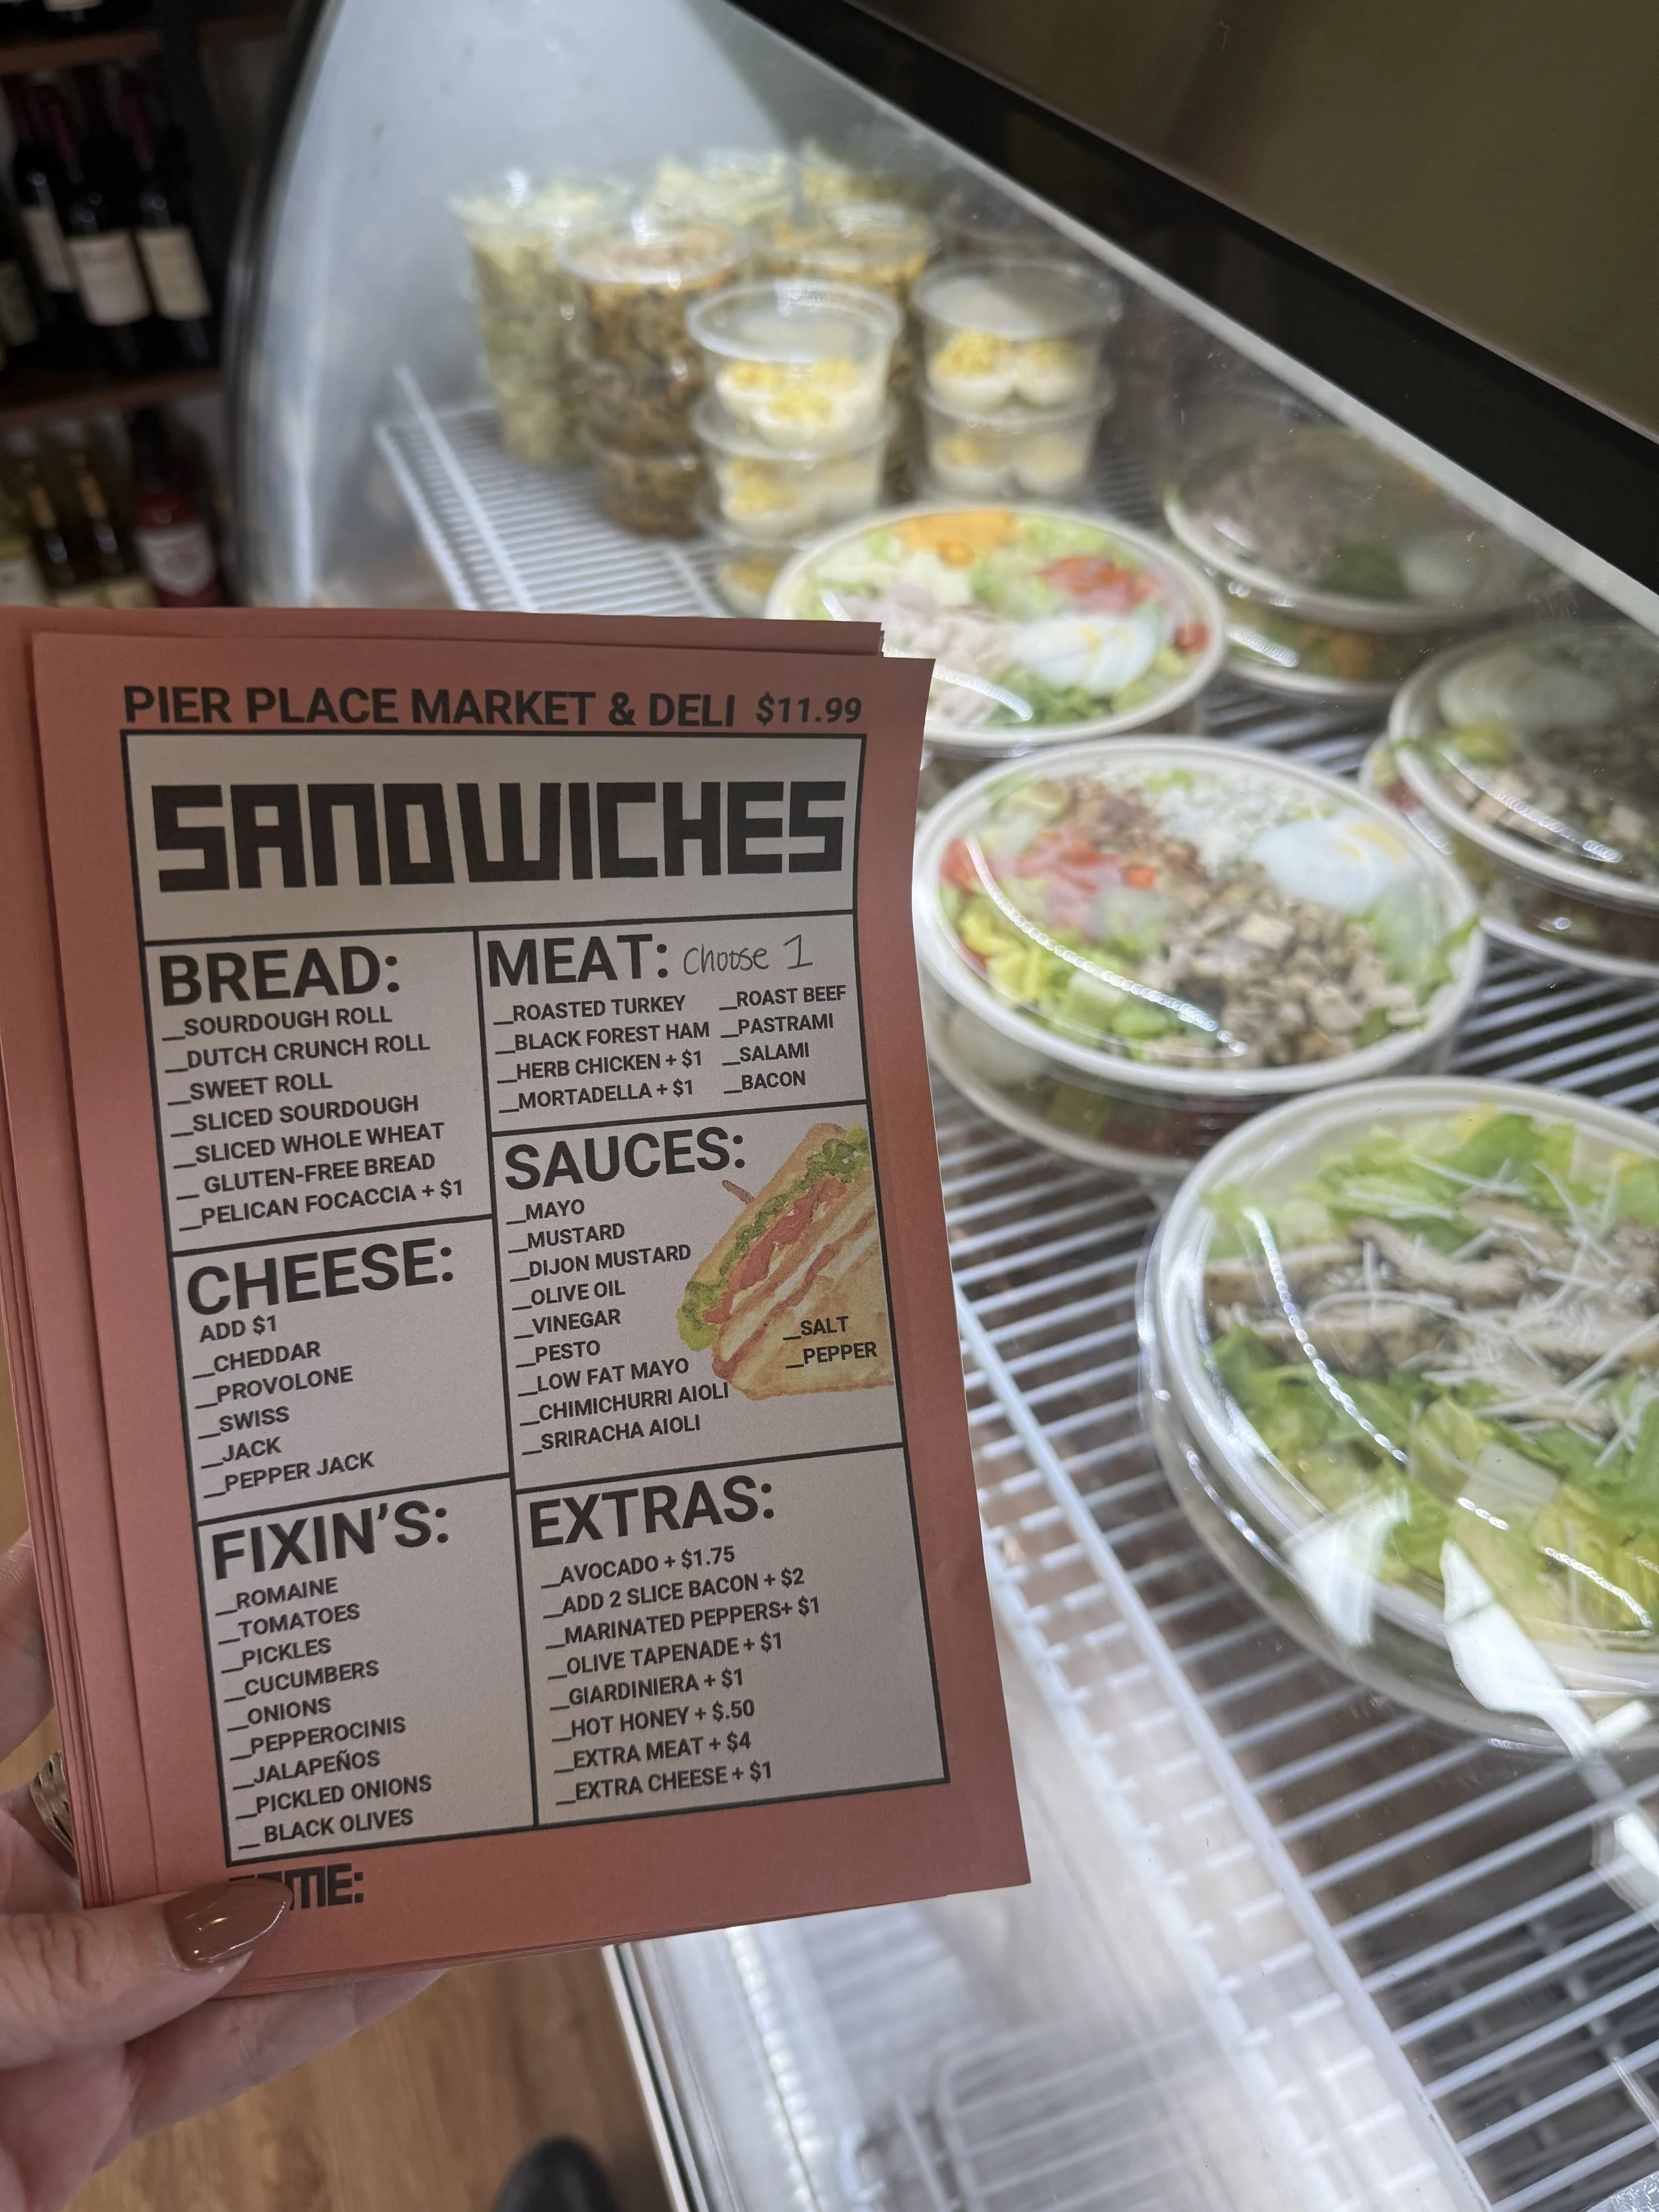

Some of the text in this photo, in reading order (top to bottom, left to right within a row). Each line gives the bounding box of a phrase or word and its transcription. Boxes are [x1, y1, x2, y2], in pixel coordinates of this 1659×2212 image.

[124, 686, 861, 727] PIER PLACE MARKET & DELI $11.99
[152, 781, 845, 892] SANDWICHES
[488, 934, 668, 987] MEAT:
[784, 934, 813, 969] 1
[160, 946, 399, 1005] BREAD:
[611, 995, 685, 1015] TURKEY
[804, 985, 845, 1002] BEEF
[336, 1006, 392, 1025] ROLL
[587, 1025, 660, 1045] FOREST
[666, 1021, 709, 1040] HAM
[274, 1038, 368, 1061] CRUNCH
[375, 1034, 430, 1053] ROLL
[575, 1053, 660, 1074] CHICKEN
[666, 1055, 676, 1066] +
[682, 1049, 701, 1069] $1
[275, 1072, 332, 1092] ROLL
[657, 1084, 668, 1095] +
[674, 1078, 692, 1098] $1
[280, 1095, 418, 1123] SOURDOUGH
[281, 1130, 362, 1153] WHOLE
[366, 1122, 445, 1145] WHEAT
[506, 1127, 745, 1190] SAUCES:
[204, 1153, 435, 1193] GLUTEN-FREE BREAD
[306, 1185, 417, 1213] FOCACCIA
[422, 1185, 434, 1197] +
[441, 1179, 462, 1199] $1
[596, 1244, 691, 1269] MUSTARD
[188, 1238, 453, 1315] CHEESE:
[594, 1280, 626, 1297] OIL
[200, 1315, 276, 1343] ADD $1
[587, 1365, 624, 1385] FAT
[631, 1358, 689, 1380] MAYO
[678, 1382, 729, 1403] AIOLI
[650, 1414, 700, 1436] AIOLI
[317, 1451, 375, 1475] JACK
[530, 1475, 774, 1548] EXTRAS:
[212, 1501, 449, 1580] FIXIN'S:
[664, 1556, 676, 1568] +
[682, 1546, 735, 1570] $1.75
[609, 1590, 621, 1607] 2
[627, 1582, 684, 1605] SLICE
[689, 1573, 758, 1597] BACON
[764, 1574, 775, 1586] +
[781, 1567, 804, 1588] $2
[798, 1595, 819, 1617] $1
[630, 1637, 739, 1666] TAPENADE
[743, 1638, 755, 1651] +
[760, 1631, 781, 1653] $1
[704, 1674, 715, 1686] +
[721, 1667, 743, 1688] $1
[620, 1706, 689, 1732] HONEY
[695, 1708, 706, 1720] +
[713, 1699, 755, 1722] $.50
[646, 1736, 703, 1760] MEAT
[709, 1737, 721, 1750] +
[727, 1731, 751, 1753] $4
[351, 1774, 431, 1800] ONIONS
[648, 1766, 727, 1791] CHEESE
[732, 1767, 743, 1780] +
[750, 1760, 770, 1782] $1
[265, 1808, 413, 1842] BLACK OLIVES
[229, 1863, 364, 1910] ME:
